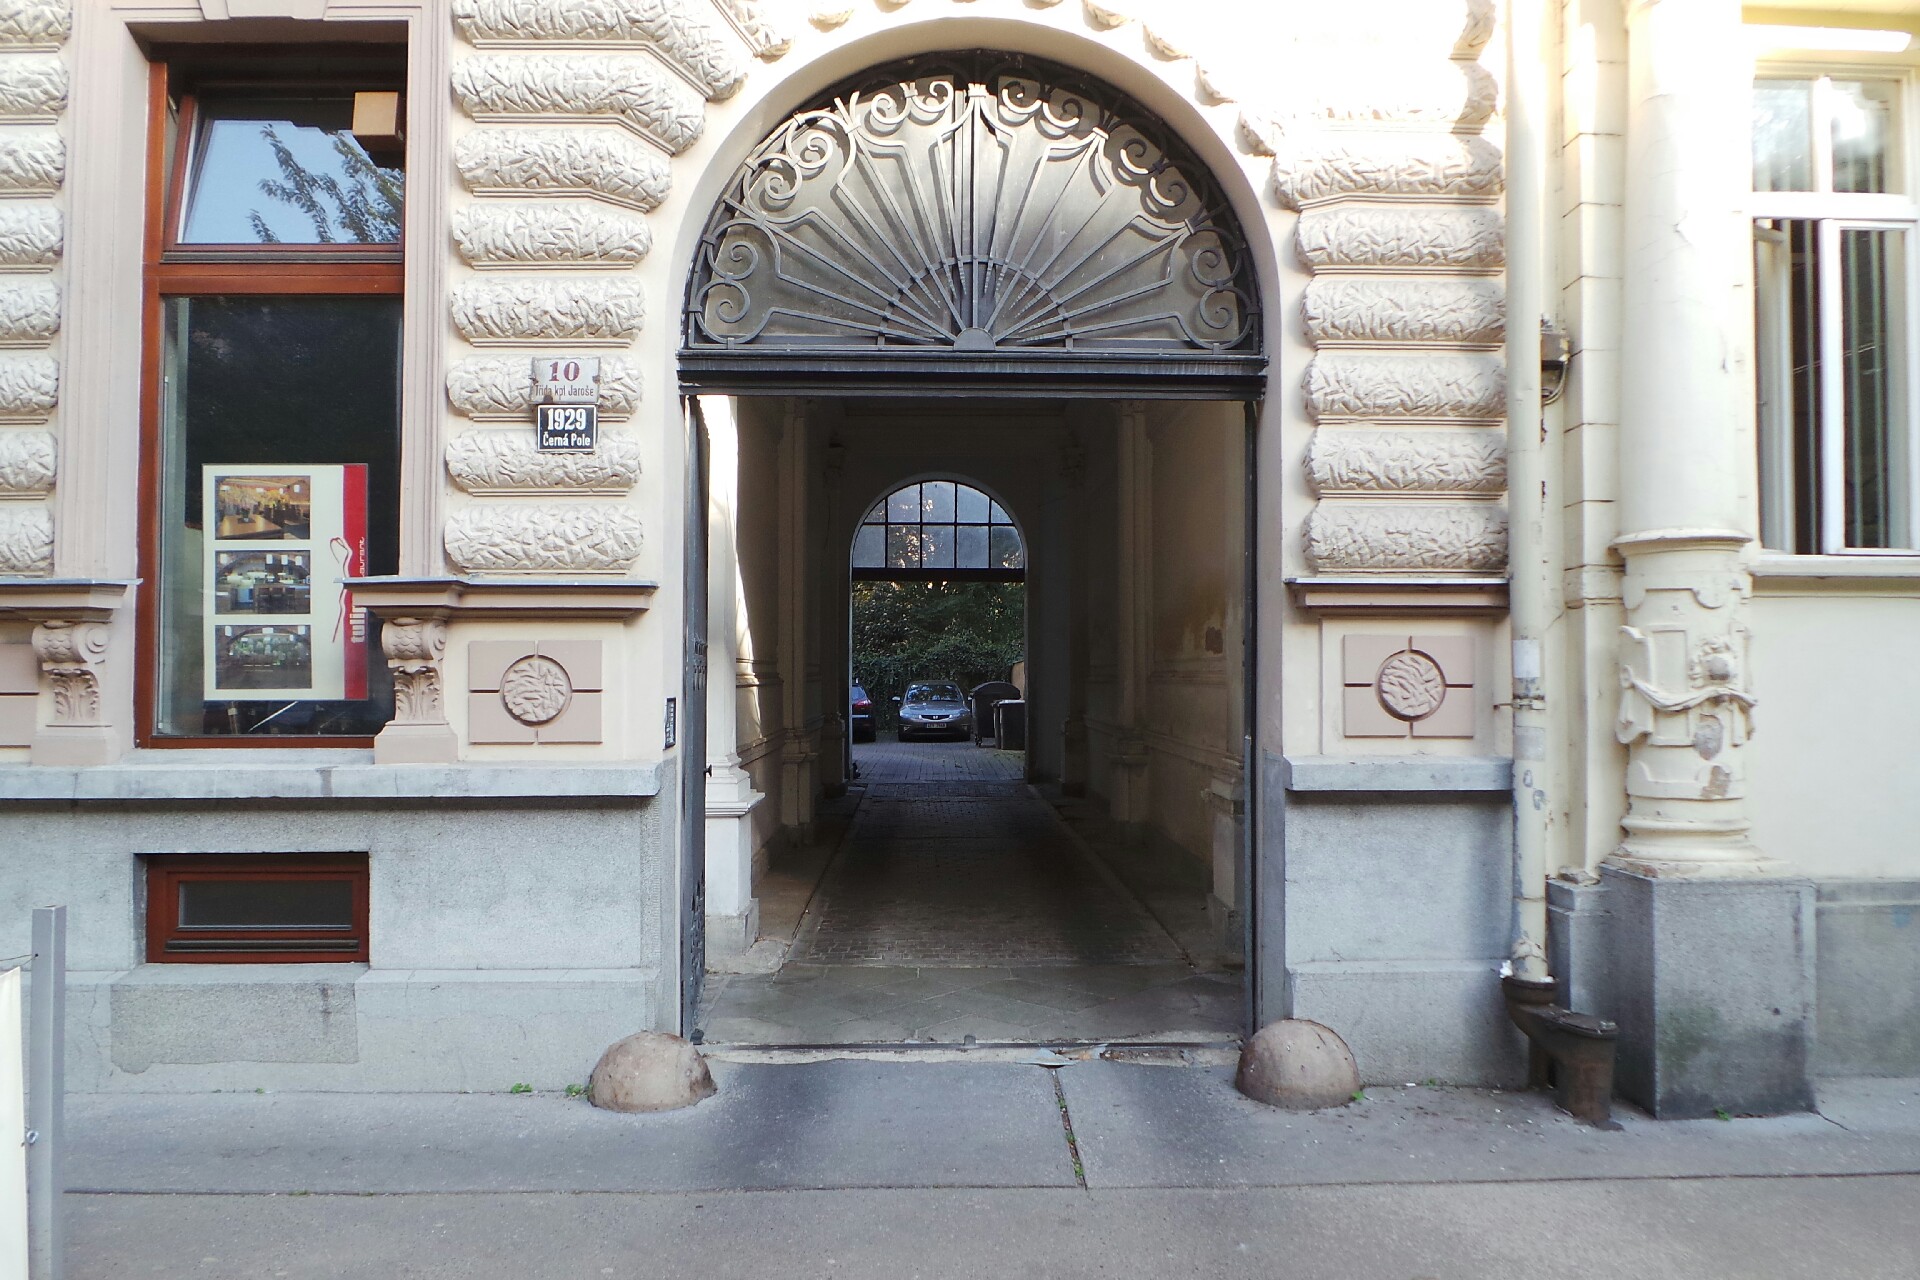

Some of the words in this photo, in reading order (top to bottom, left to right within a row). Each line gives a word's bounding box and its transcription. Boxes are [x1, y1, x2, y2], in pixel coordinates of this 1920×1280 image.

[549, 361, 580, 382] 10
[568, 385, 594, 396] Jaroše
[547, 408, 586, 430] 1929
[543, 432, 569, 446] Černá
[571, 433, 591, 446] Pole
